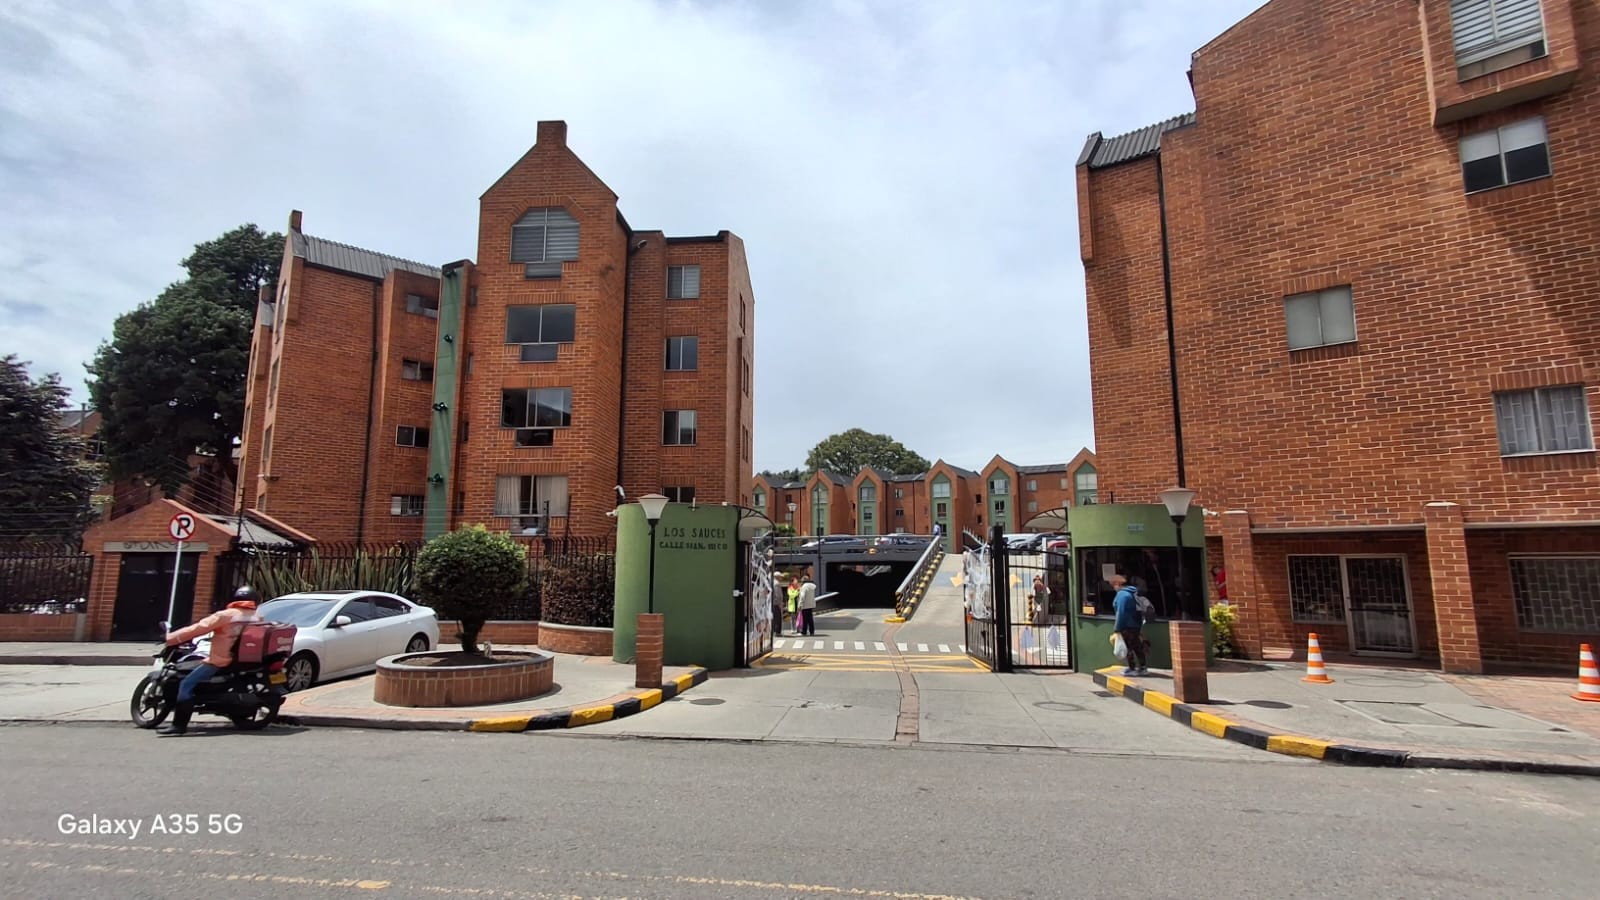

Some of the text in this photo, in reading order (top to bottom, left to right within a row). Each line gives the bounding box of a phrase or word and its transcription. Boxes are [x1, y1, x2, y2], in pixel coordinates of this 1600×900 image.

[664, 527, 726, 539] LOS SAUCES
[659, 541, 684, 549] CALLE
